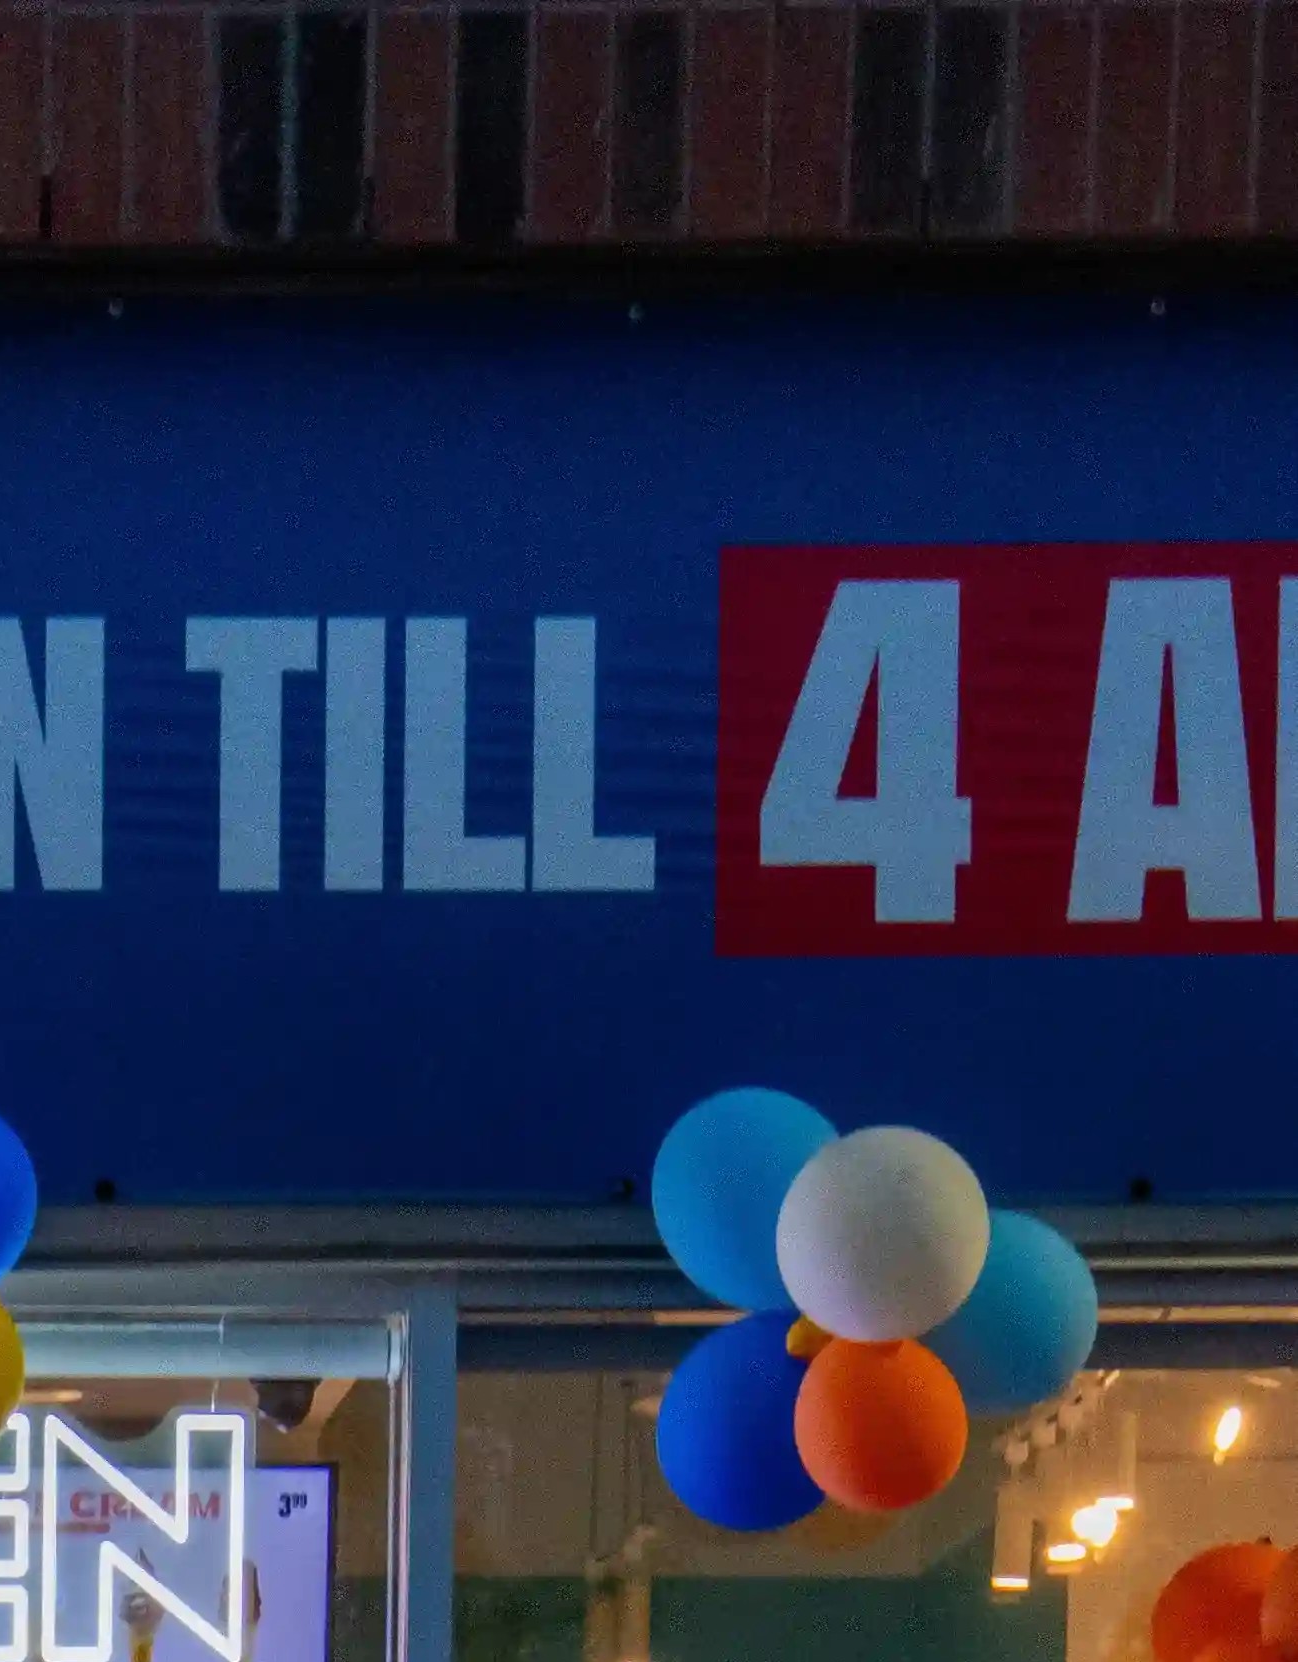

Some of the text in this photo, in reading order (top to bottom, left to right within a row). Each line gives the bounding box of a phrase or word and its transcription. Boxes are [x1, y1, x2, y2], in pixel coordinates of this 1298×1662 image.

[185, 615, 657, 893] TILL
[758, 577, 973, 924] 4
[1065, 573, 1298, 924] A
